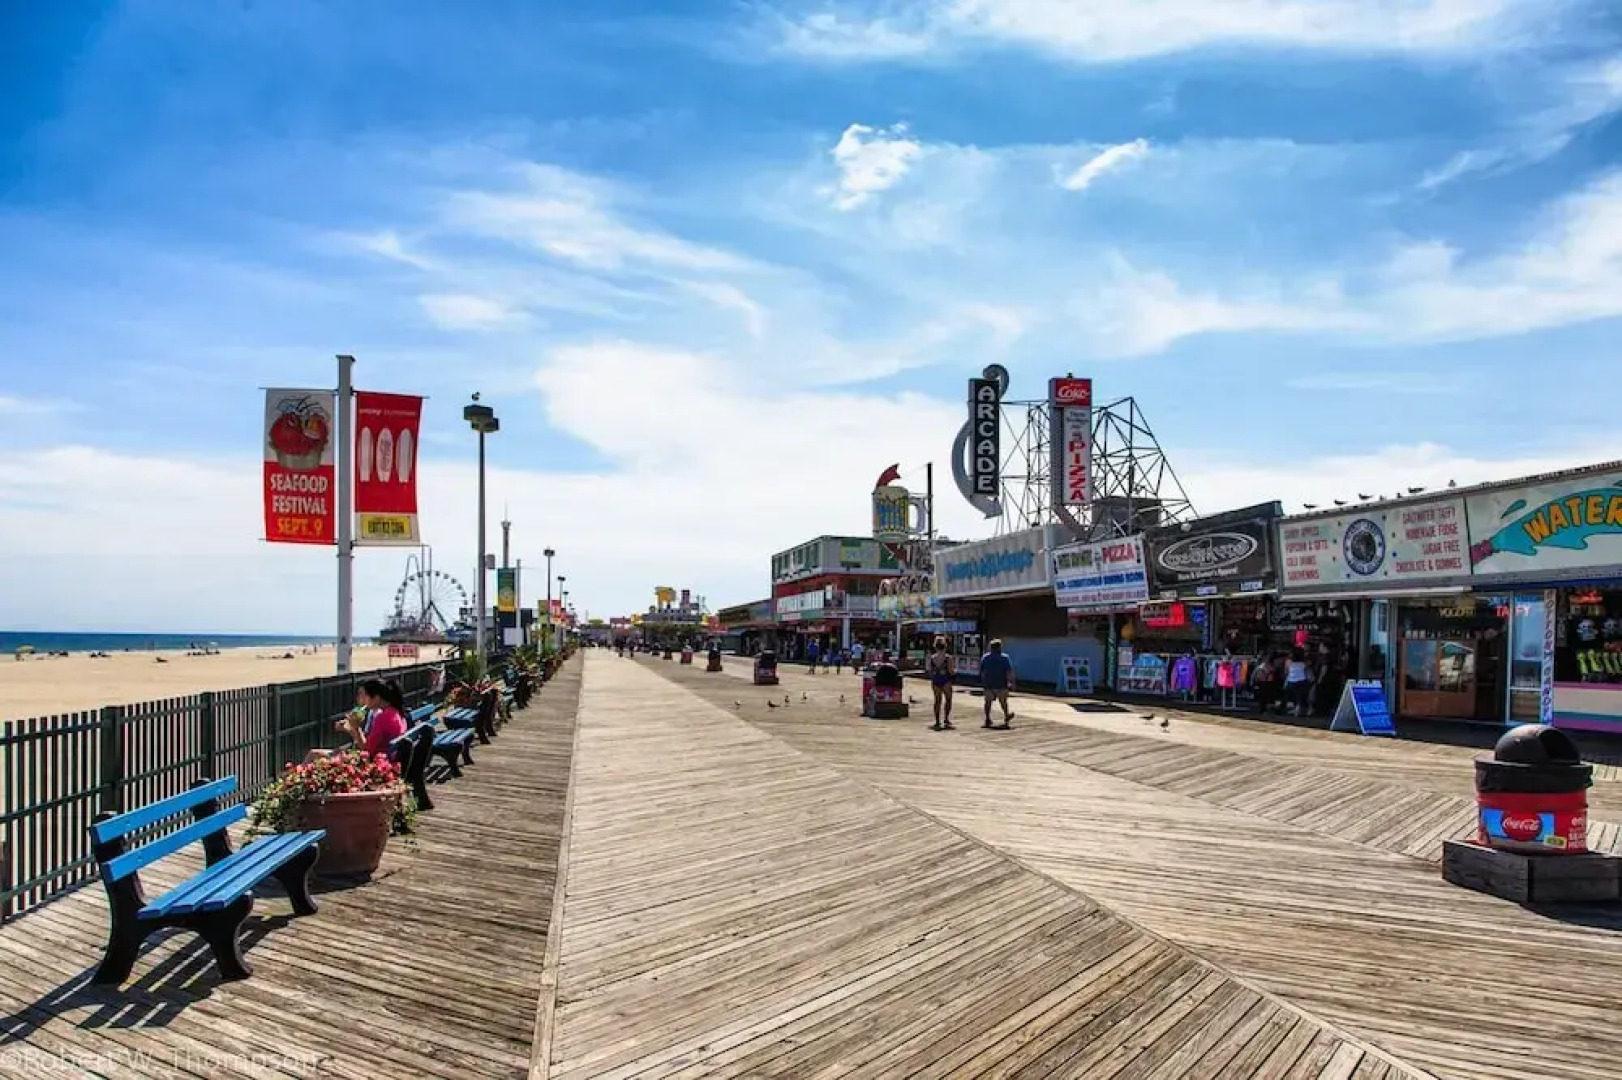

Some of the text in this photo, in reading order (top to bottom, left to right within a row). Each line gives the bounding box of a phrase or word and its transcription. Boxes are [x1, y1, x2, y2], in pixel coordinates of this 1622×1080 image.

[1057, 384, 1090, 399] Coke
[977, 385, 996, 491] ARCADE
[1068, 440, 1086, 500] PIZZA
[270, 473, 328, 493] SEAFOOD
[272, 495, 328, 515] FESTIVAL
[277, 518, 313, 536] SEPT.
[1405, 522, 1458, 540] HOMEMADE FUDGE
[1102, 543, 1135, 564] PIZZA
[1422, 540, 1460, 555] SUGAR FREE
[1396, 560, 1426, 573] CHOCOLATE
[1494, 604, 1532, 617] TAFY
